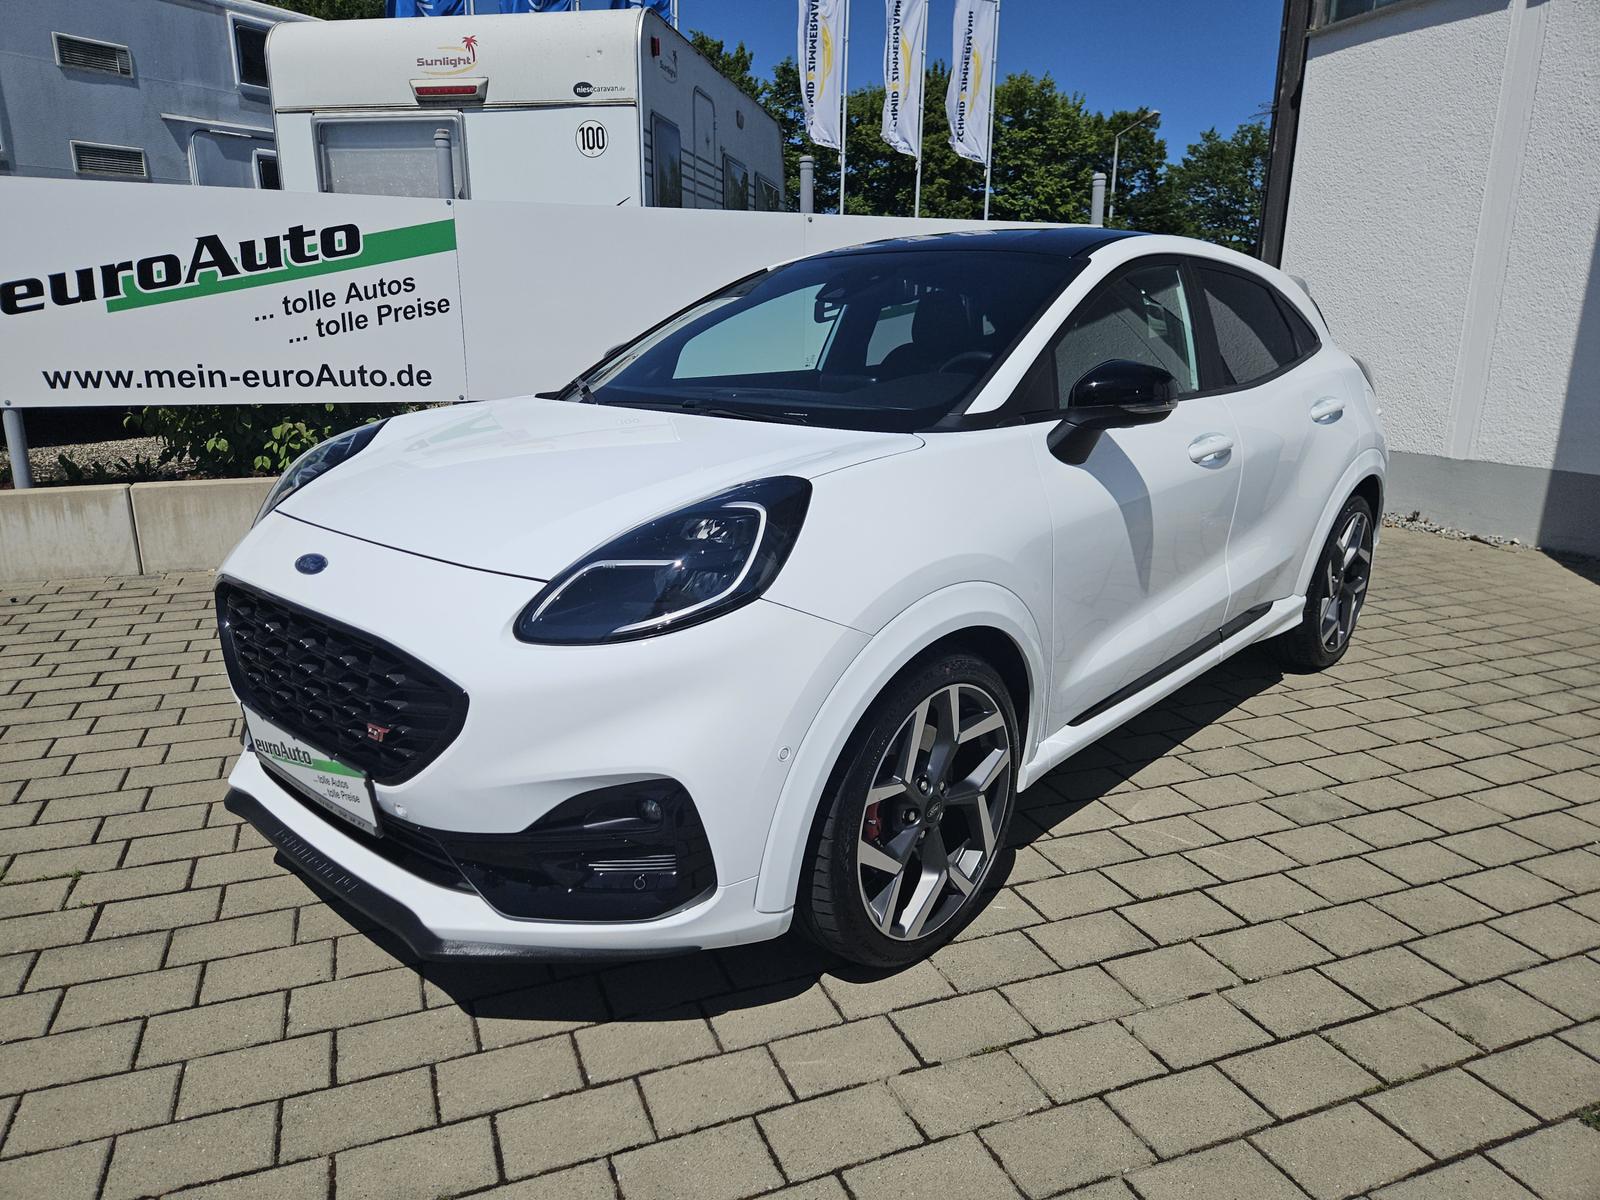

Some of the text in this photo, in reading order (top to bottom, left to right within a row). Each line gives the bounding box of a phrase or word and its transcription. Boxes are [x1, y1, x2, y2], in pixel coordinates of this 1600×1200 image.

[416, 56, 472, 68] Sunlight
[579, 126, 605, 151] 100
[0, 223, 361, 315] euroAuto
[282, 289, 336, 316] tolle
[345, 277, 416, 304] Autos
[316, 312, 368, 338] tolle
[377, 297, 450, 325] Preise
[42, 364, 432, 389] www.mein-euroAuto.de
[254, 738, 313, 765] euroAuto
